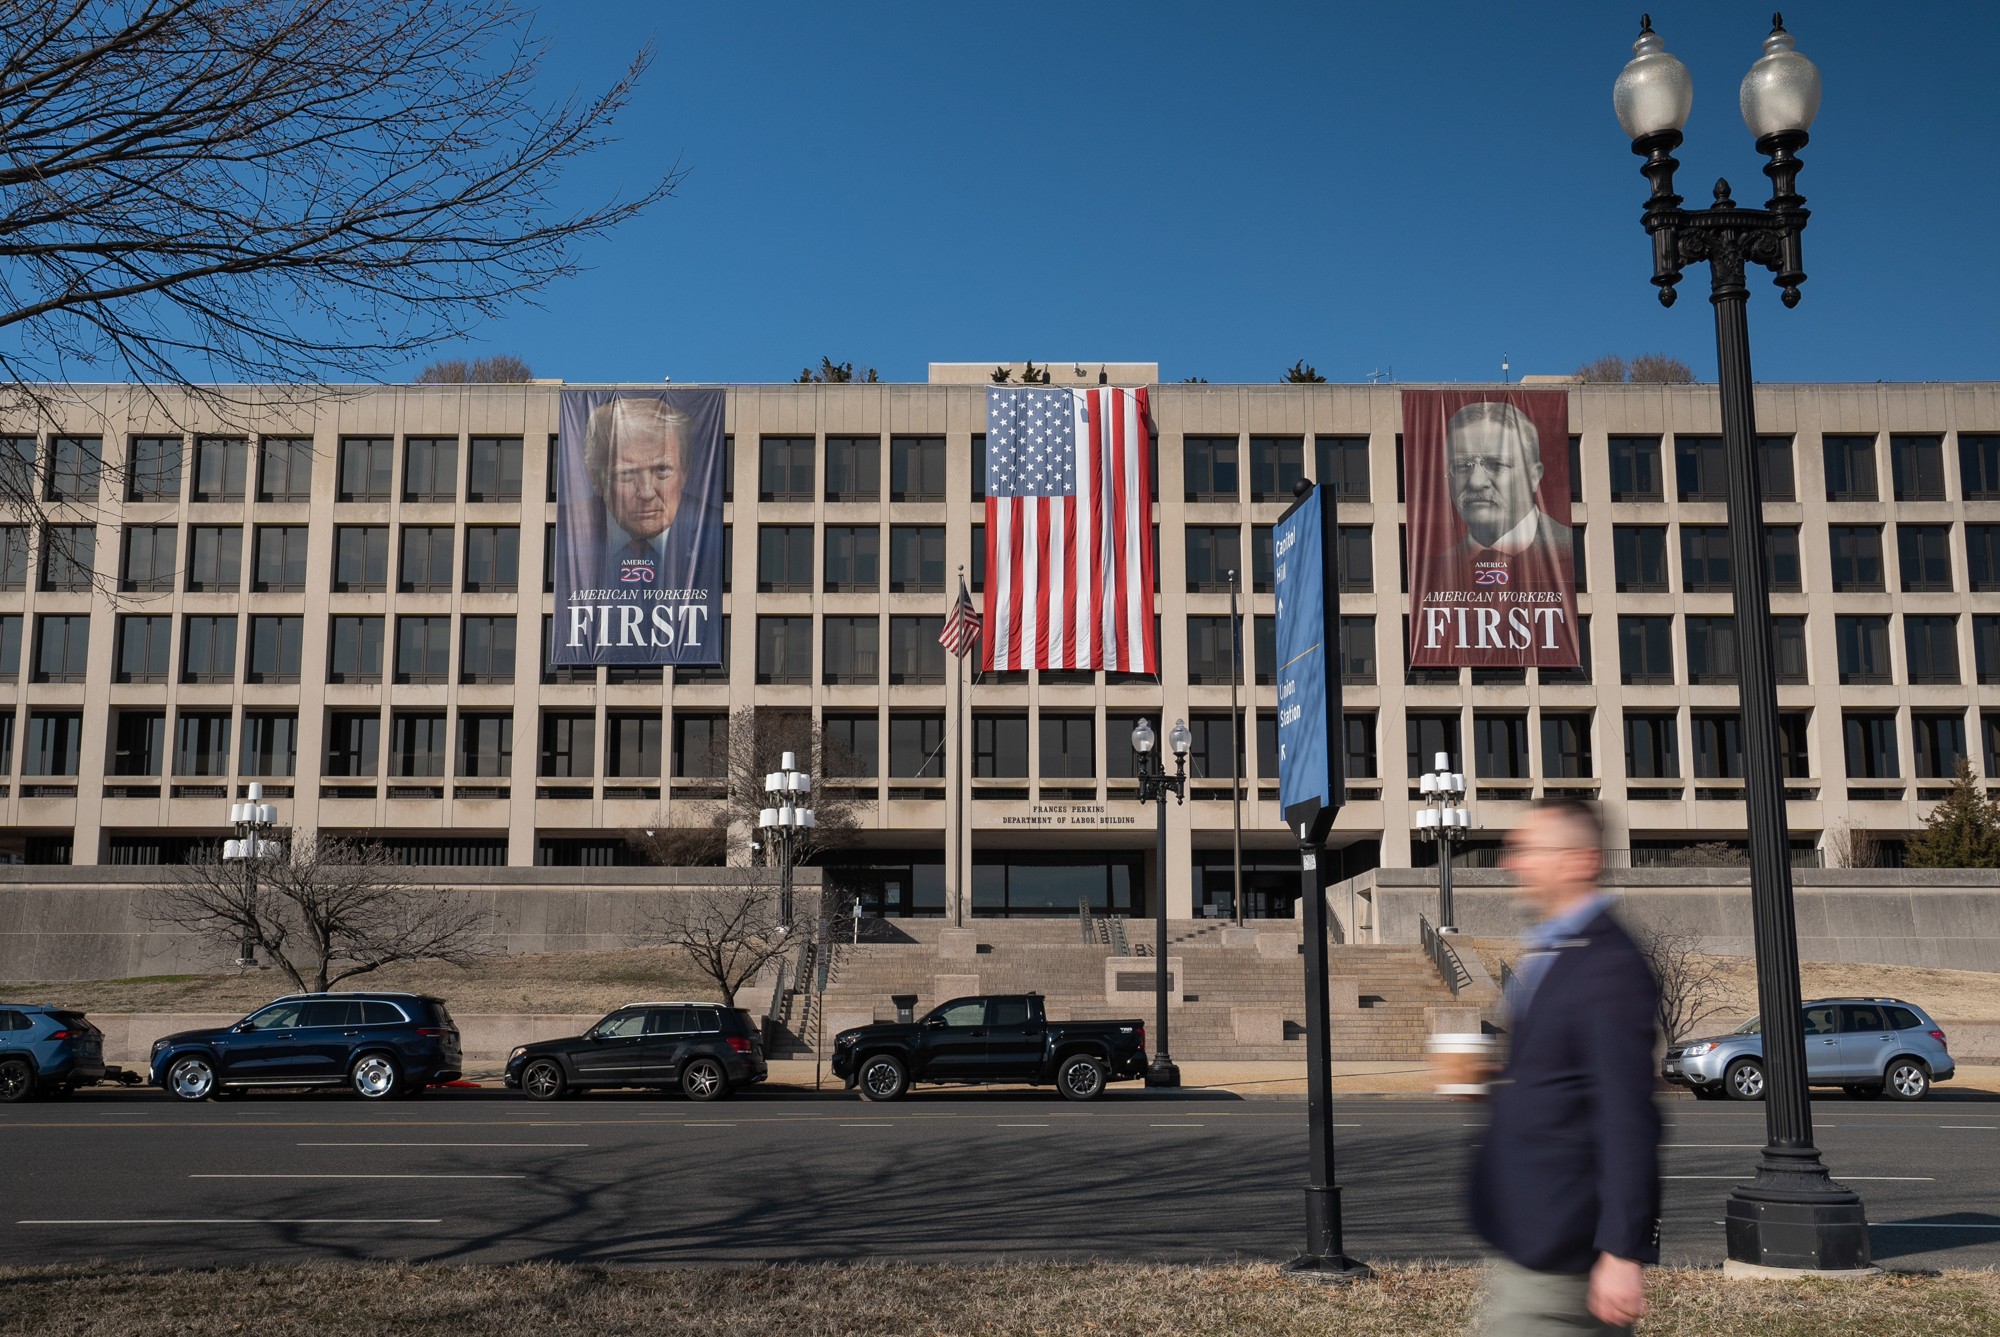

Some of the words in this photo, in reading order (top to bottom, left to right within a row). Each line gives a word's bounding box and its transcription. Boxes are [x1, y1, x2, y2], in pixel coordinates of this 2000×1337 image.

[1276, 526, 1296, 558] Capitol
[620, 567, 656, 583] 250
[1276, 561, 1286, 585] Hill
[1474, 570, 1509, 586] 250
[568, 589, 639, 601] AMERICAN
[642, 588, 708, 600] WORKERS
[1423, 591, 1494, 602] AMERICAN
[1498, 592, 1562, 602] WORKERS
[566, 605, 708, 647] FIRST
[1422, 607, 1564, 650] FIRST
[1279, 679, 1296, 700] Union
[1280, 704, 1301, 728] Station
